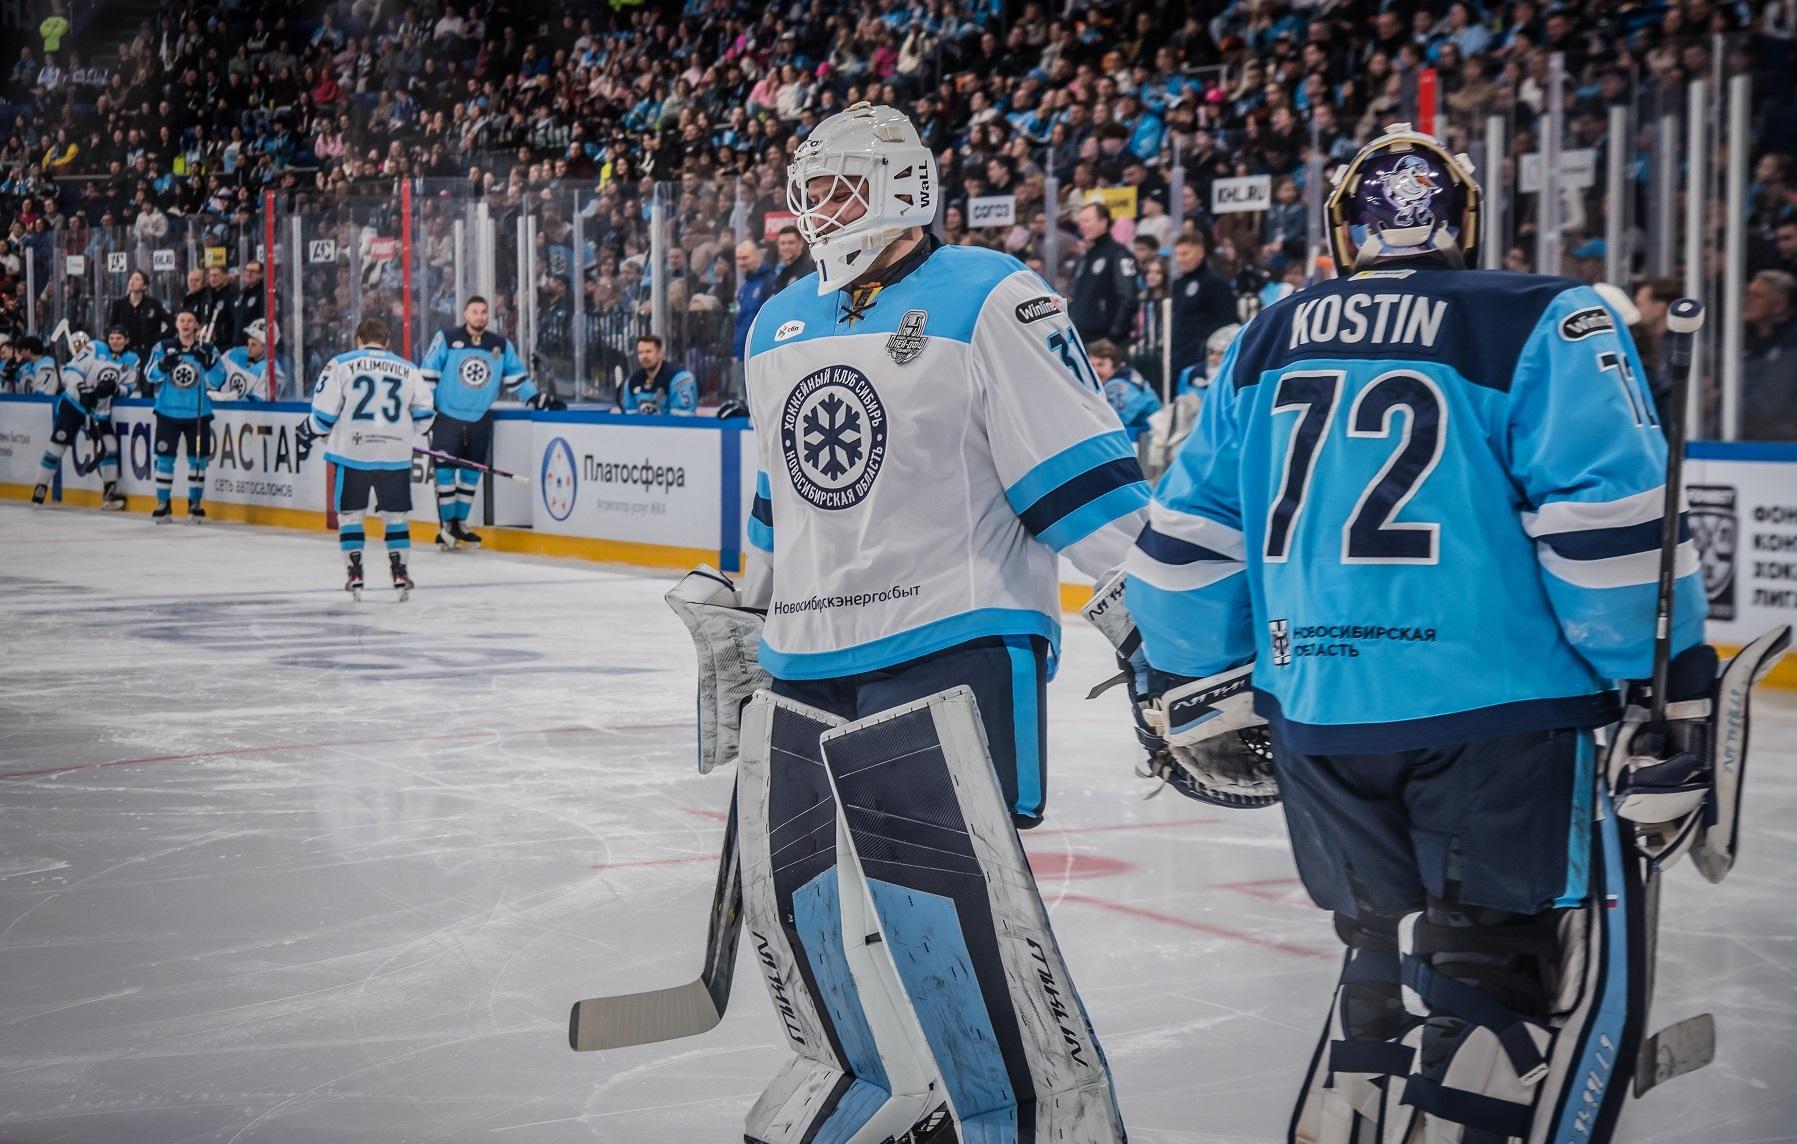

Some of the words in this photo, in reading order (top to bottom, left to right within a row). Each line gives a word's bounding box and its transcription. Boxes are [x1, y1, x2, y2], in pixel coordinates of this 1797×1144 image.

[1289, 292, 1448, 351] KOSTIN
[351, 374, 404, 424] 23
[784, 367, 832, 432] ХОККЕЙНЫЙ
[833, 368, 859, 387] КЛУБ
[856, 380, 883, 428] СИБИРЬ
[584, 454, 685, 494] Платосфера
[785, 449, 857, 507] НОВОСИБИРСКАЯ
[855, 446, 883, 497] ОБЛАСТЬ
[1263, 368, 1449, 566] 72
[774, 585, 921, 615] Новосибирскэнергосбыт
[1752, 589, 1797, 608] ЛИГ
[1293, 625, 1437, 642] НОВОСИБИРСКАЯ
